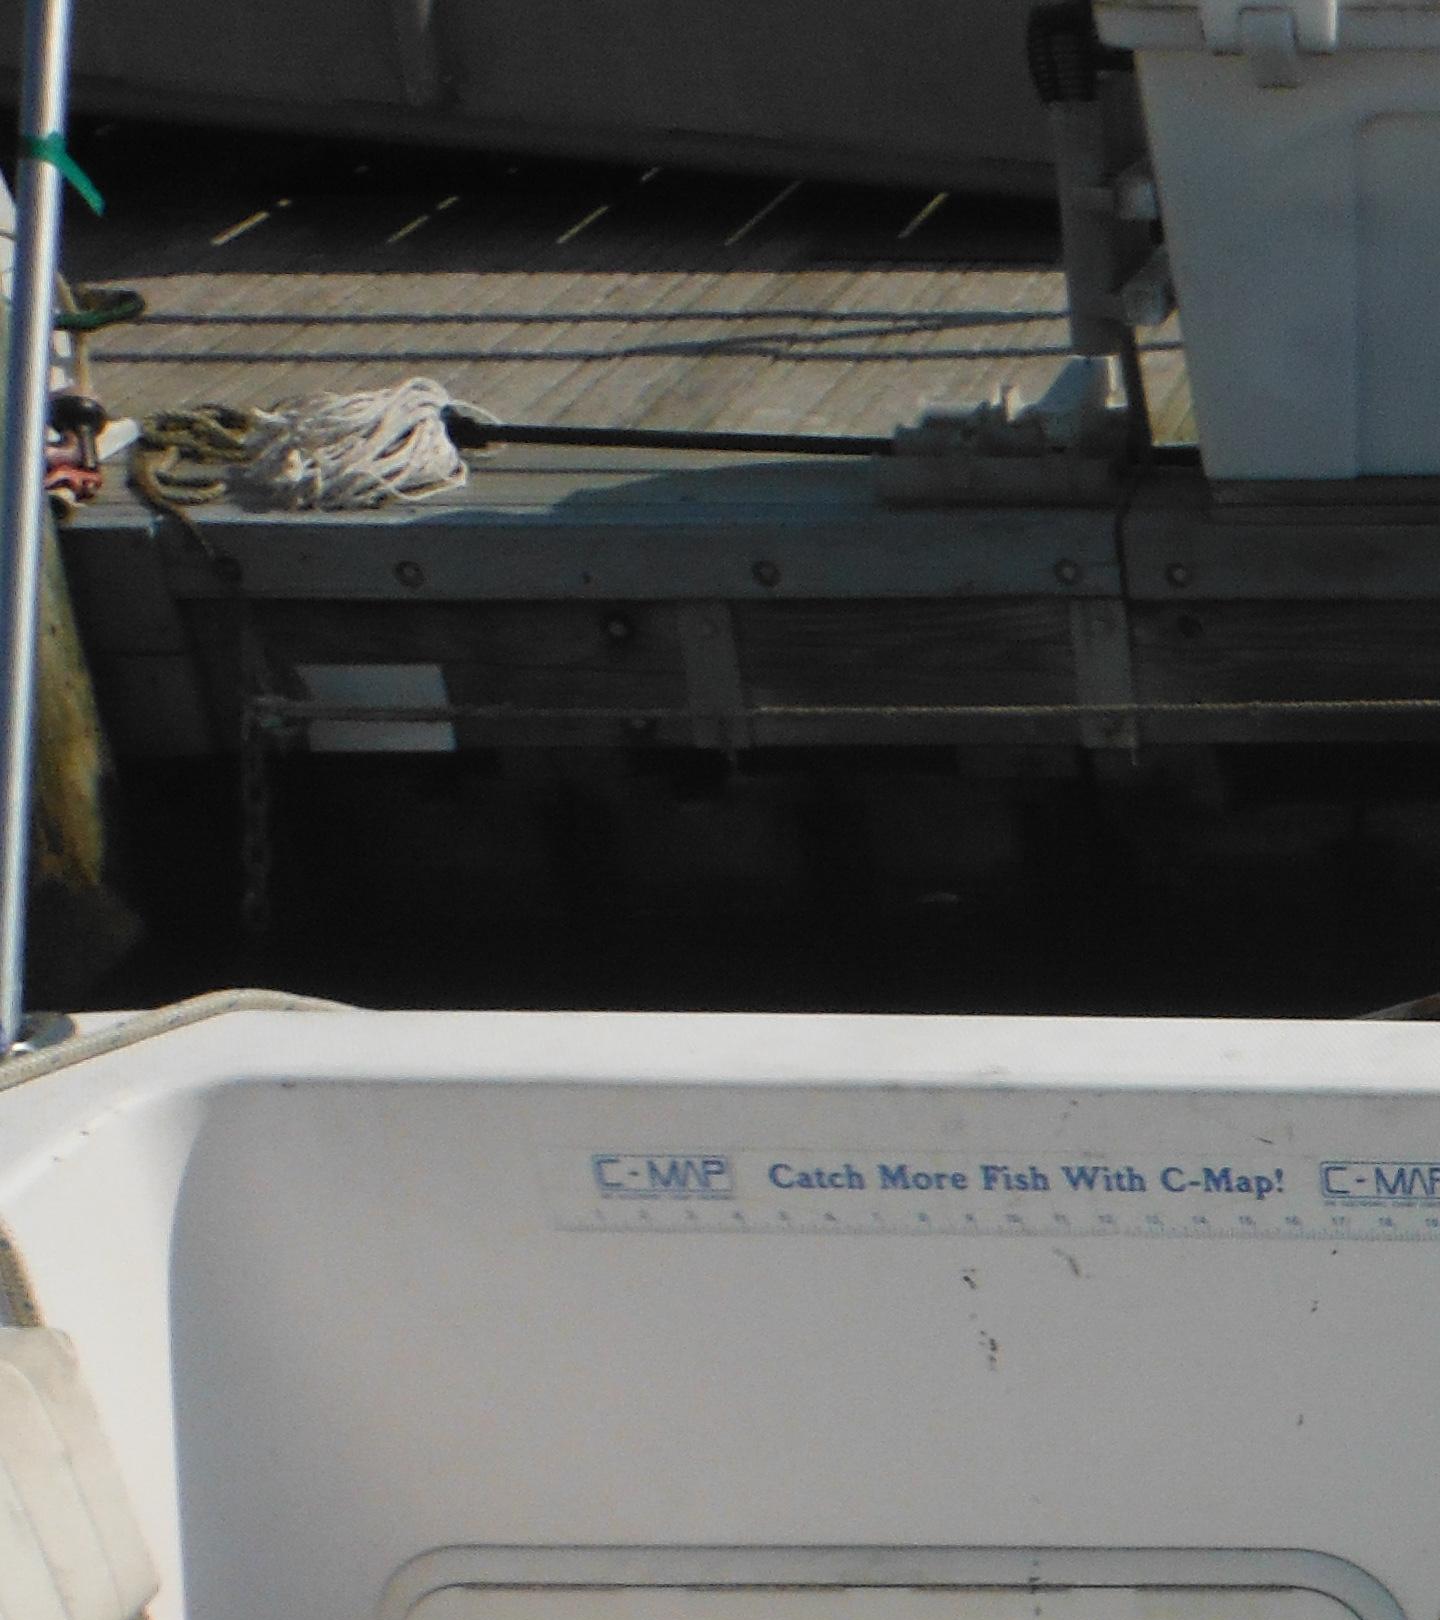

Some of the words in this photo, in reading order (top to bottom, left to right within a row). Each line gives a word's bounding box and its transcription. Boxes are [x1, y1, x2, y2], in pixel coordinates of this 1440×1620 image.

[594, 1157, 727, 1189] C-MAP
[767, 1162, 866, 1190] Catch
[877, 1163, 969, 1191] More
[979, 1164, 1051, 1192] Fish
[1060, 1164, 1147, 1193] With
[1160, 1165, 1285, 1201] C-Map!
